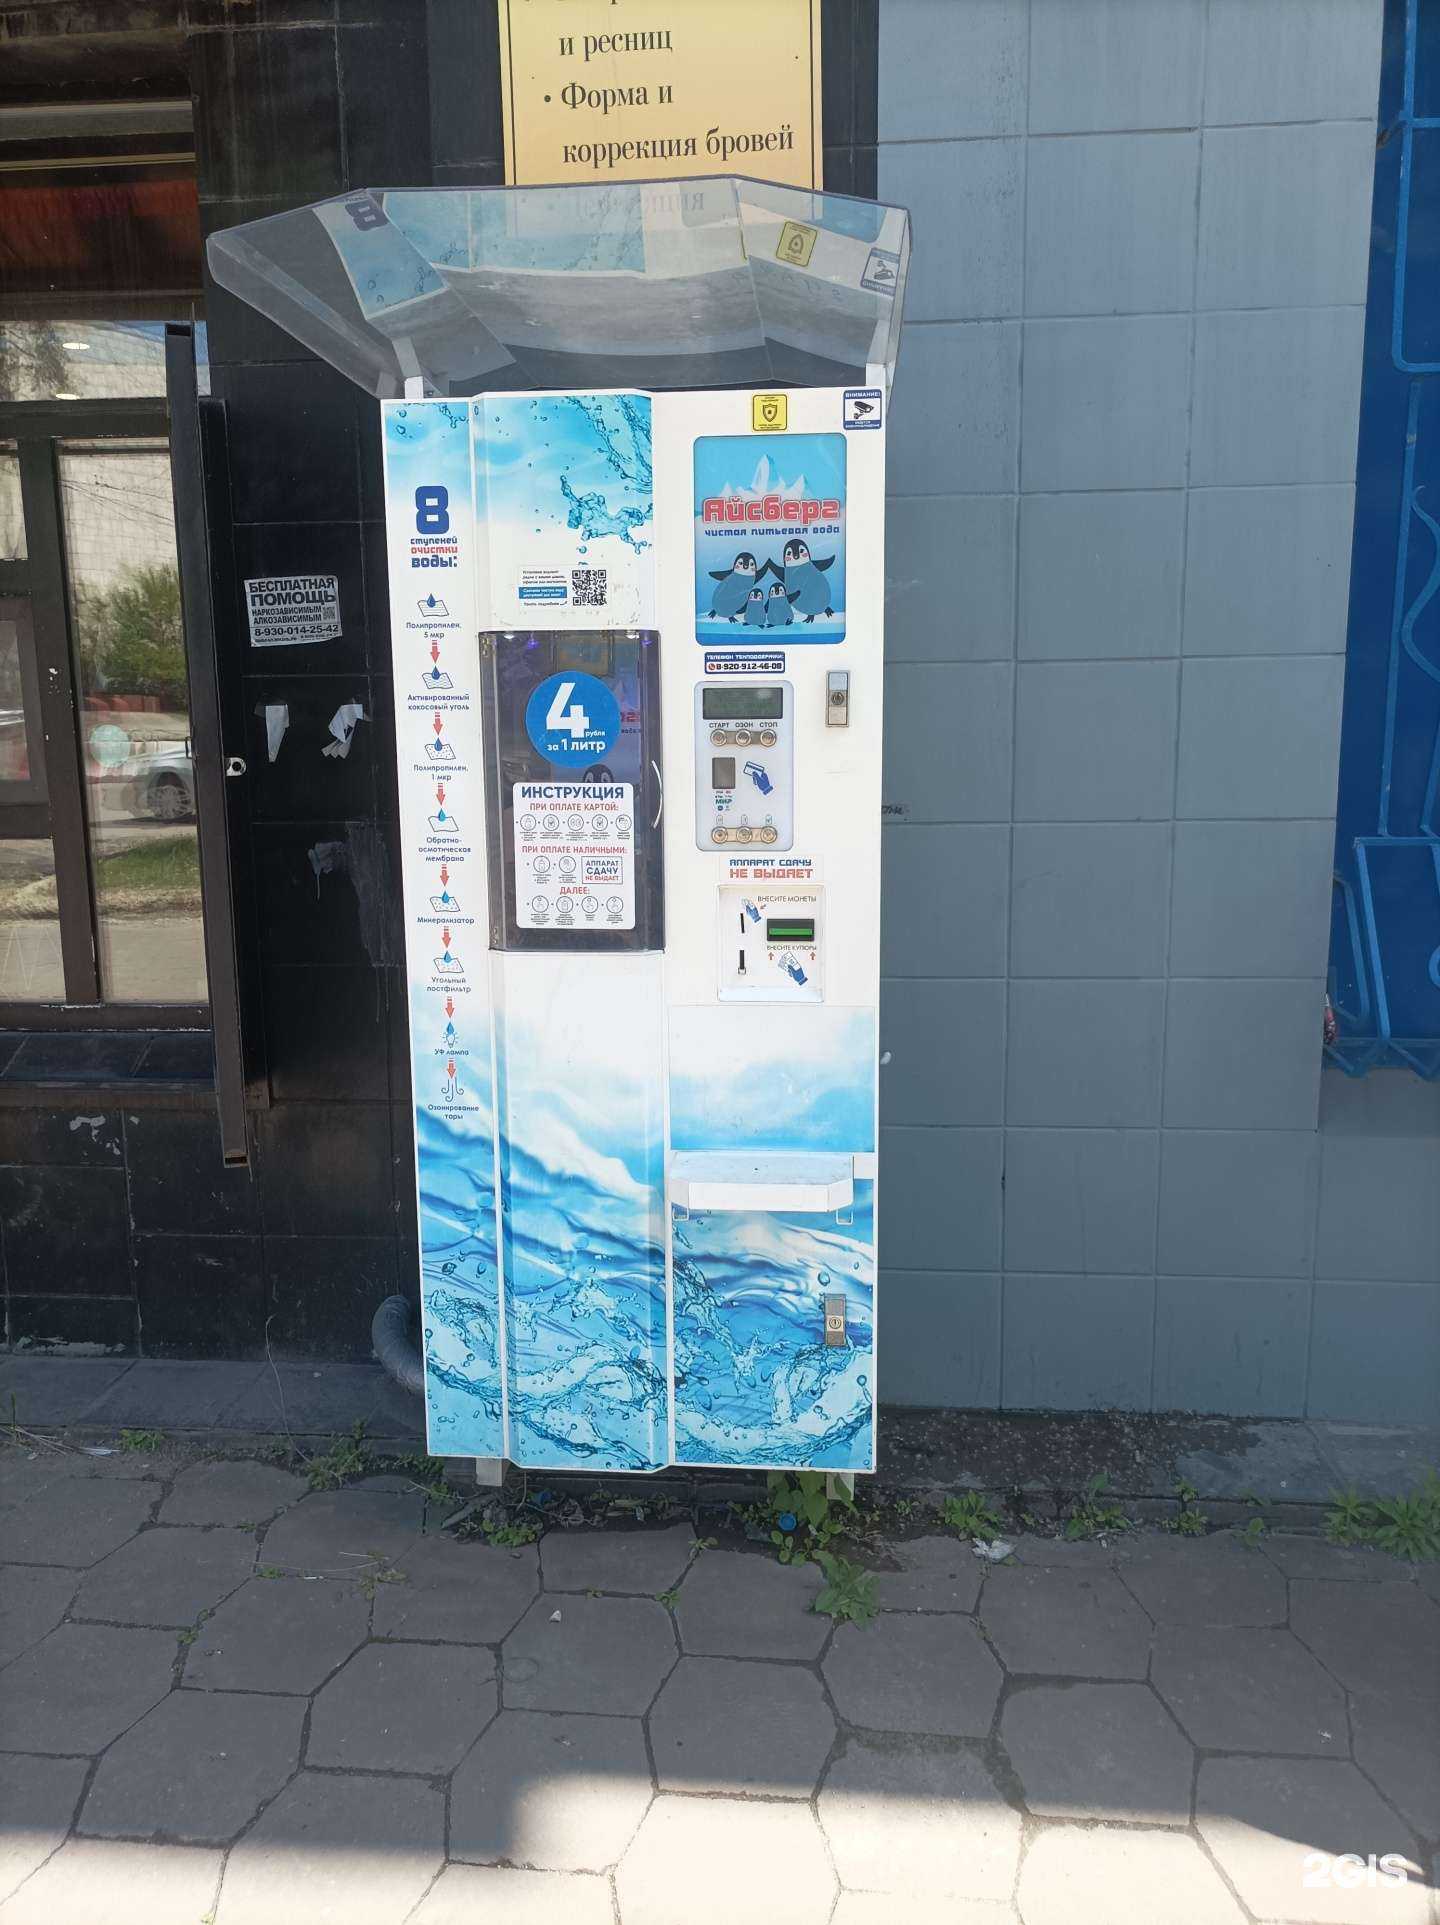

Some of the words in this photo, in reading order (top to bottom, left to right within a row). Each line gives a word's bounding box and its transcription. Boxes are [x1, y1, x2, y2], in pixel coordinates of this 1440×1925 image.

[559, 36, 574, 56] и
[584, 30, 673, 62] ресниц
[561, 82, 649, 115] Форма
[658, 84, 673, 104] и
[563, 133, 697, 169] коррекция
[706, 124, 795, 162] бровей
[415, 486, 450, 534] 8
[703, 495, 841, 526] Айсберг
[704, 529, 747, 537] чистая
[751, 528, 809, 537] питьевая
[812, 526, 841, 534] вода
[410, 536, 458, 546] ступеней
[411, 546, 458, 554] очистки
[411, 555, 458, 568] воды:
[248, 578, 336, 593] БЕСПЛАТНАЯ
[250, 590, 337, 607] ПОМОЩЬ
[251, 606, 321, 616] НАРКОЗАВИСИМЫМ
[253, 614, 322, 625] АЛКОЗАВИСИМЫМ
[254, 625, 339, 637] 8-930-014-25-42
[408, 693, 470, 702] Активированный
[546, 682, 590, 738] 4
[547, 743, 559, 751] за
[561, 739, 568, 751] 1
[571, 740, 606, 753] литр
[522, 786, 624, 801] ИНСТРУКЦИЯ
[549, 803, 581, 811] ОПЛАТЕ
[584, 802, 619, 811] КАРТОЙ:
[573, 846, 628, 854] НАЛИЧНЫМИ:
[586, 867, 618, 875] СДАЧУ
[730, 869, 748, 878] НЕ
[754, 869, 813, 878] ВЫДАЕТ
[560, 887, 590, 895] ДАЛЕЕ:
[417, 917, 475, 925] Минерализатор
[428, 1104, 480, 1112] Озонирование
